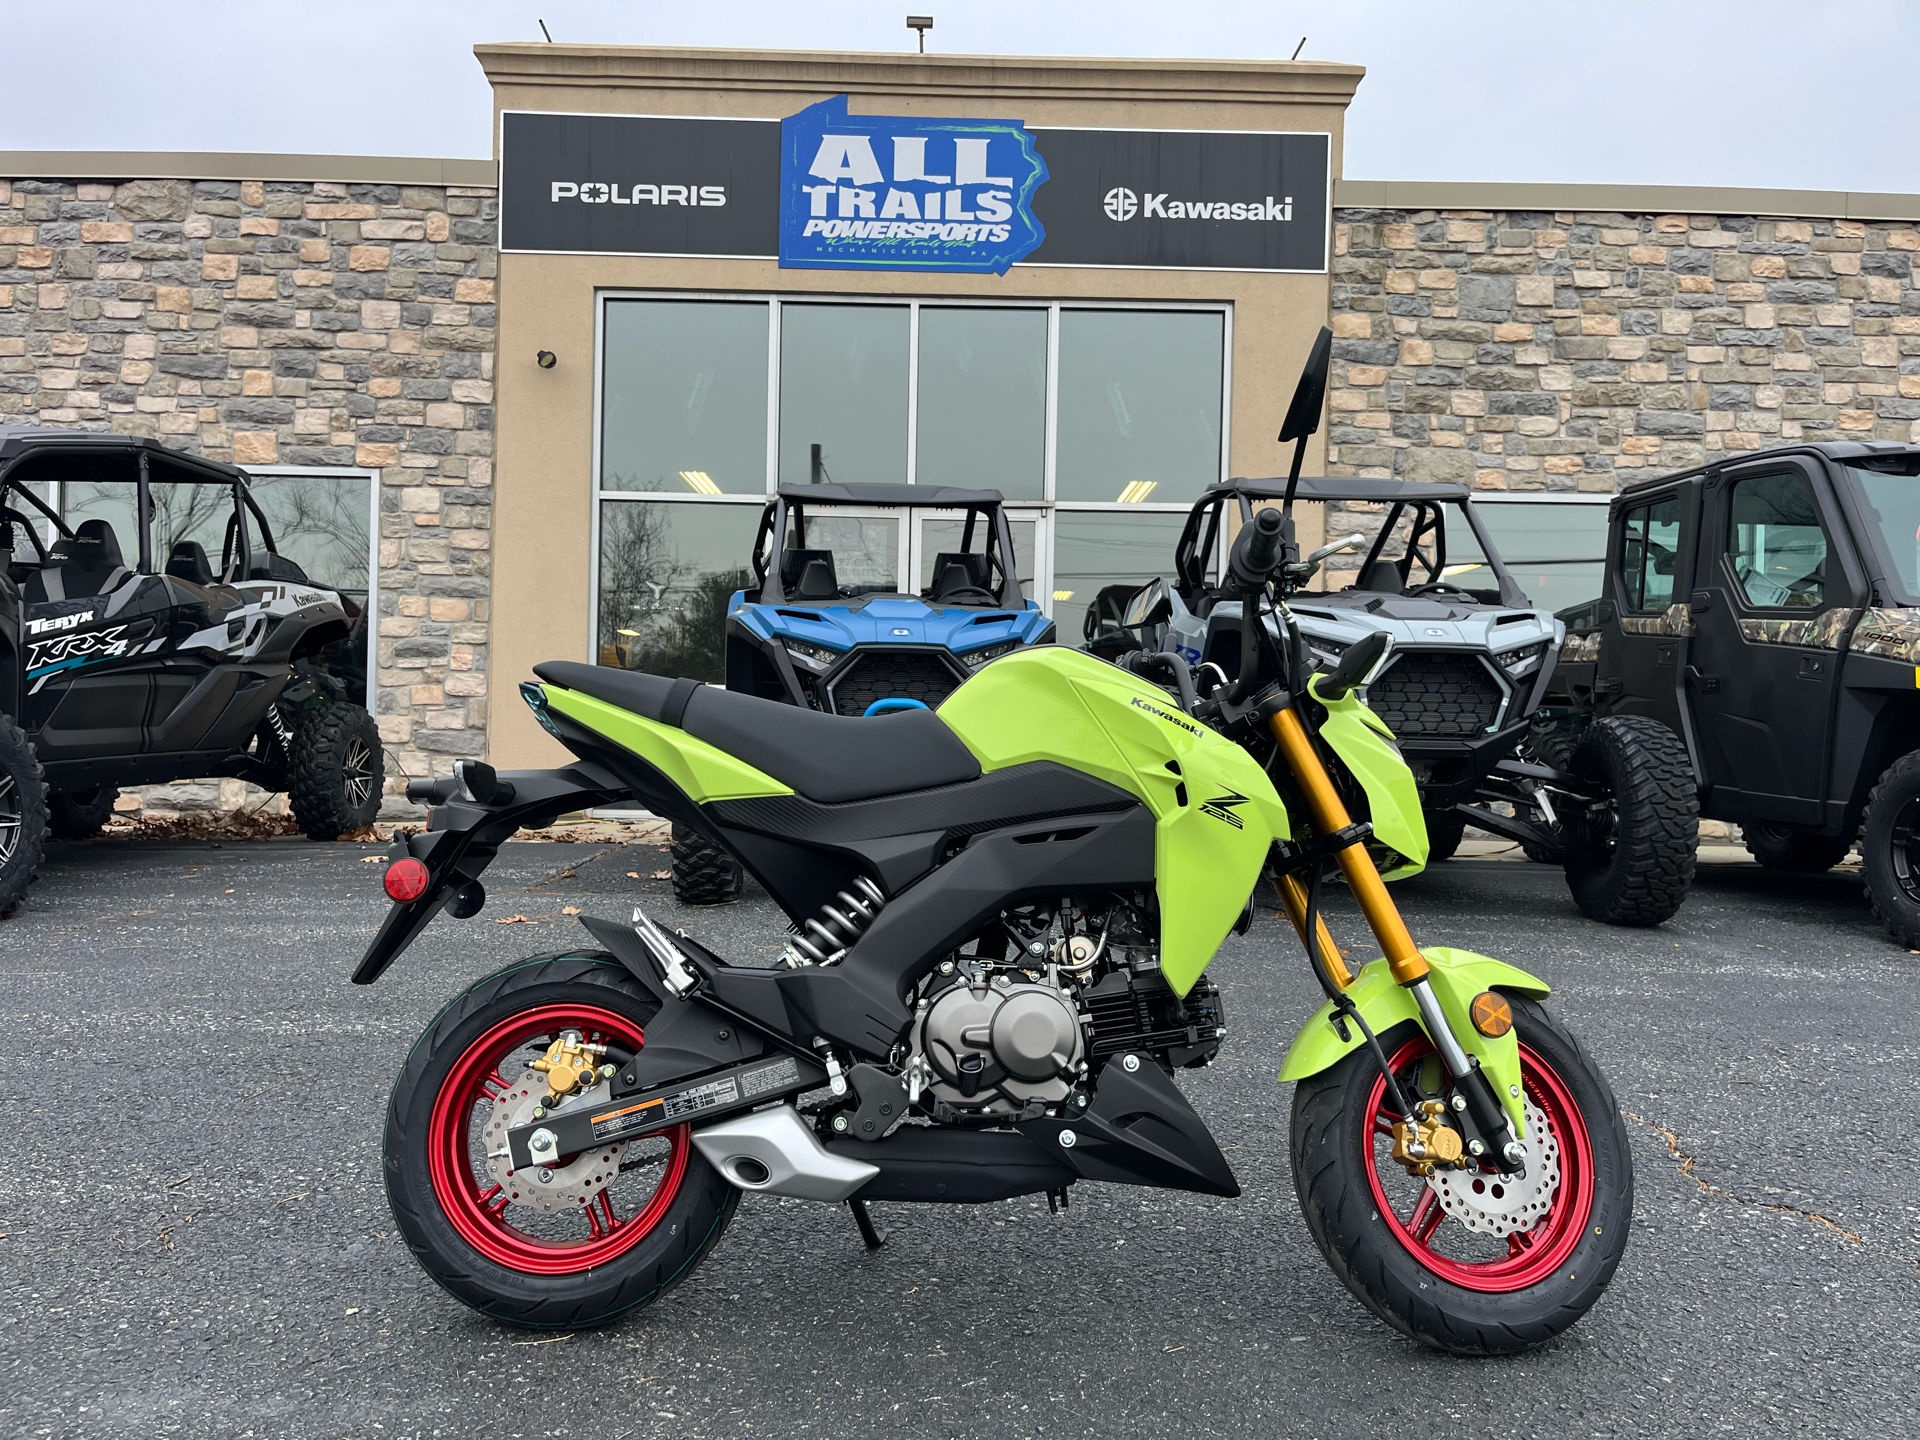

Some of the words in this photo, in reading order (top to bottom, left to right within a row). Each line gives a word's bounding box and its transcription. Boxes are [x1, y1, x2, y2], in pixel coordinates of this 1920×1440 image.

[808, 134, 1013, 189] ALL
[551, 181, 727, 207] POLARIS
[802, 185, 1013, 222] TRAILS
[1143, 193, 1293, 221] Kawasaki
[802, 219, 1011, 243] POWERSPORTS
[1864, 632, 1907, 645] 1000
[1130, 697, 1204, 739] Kawasaki
[1197, 804, 1244, 830] 125
